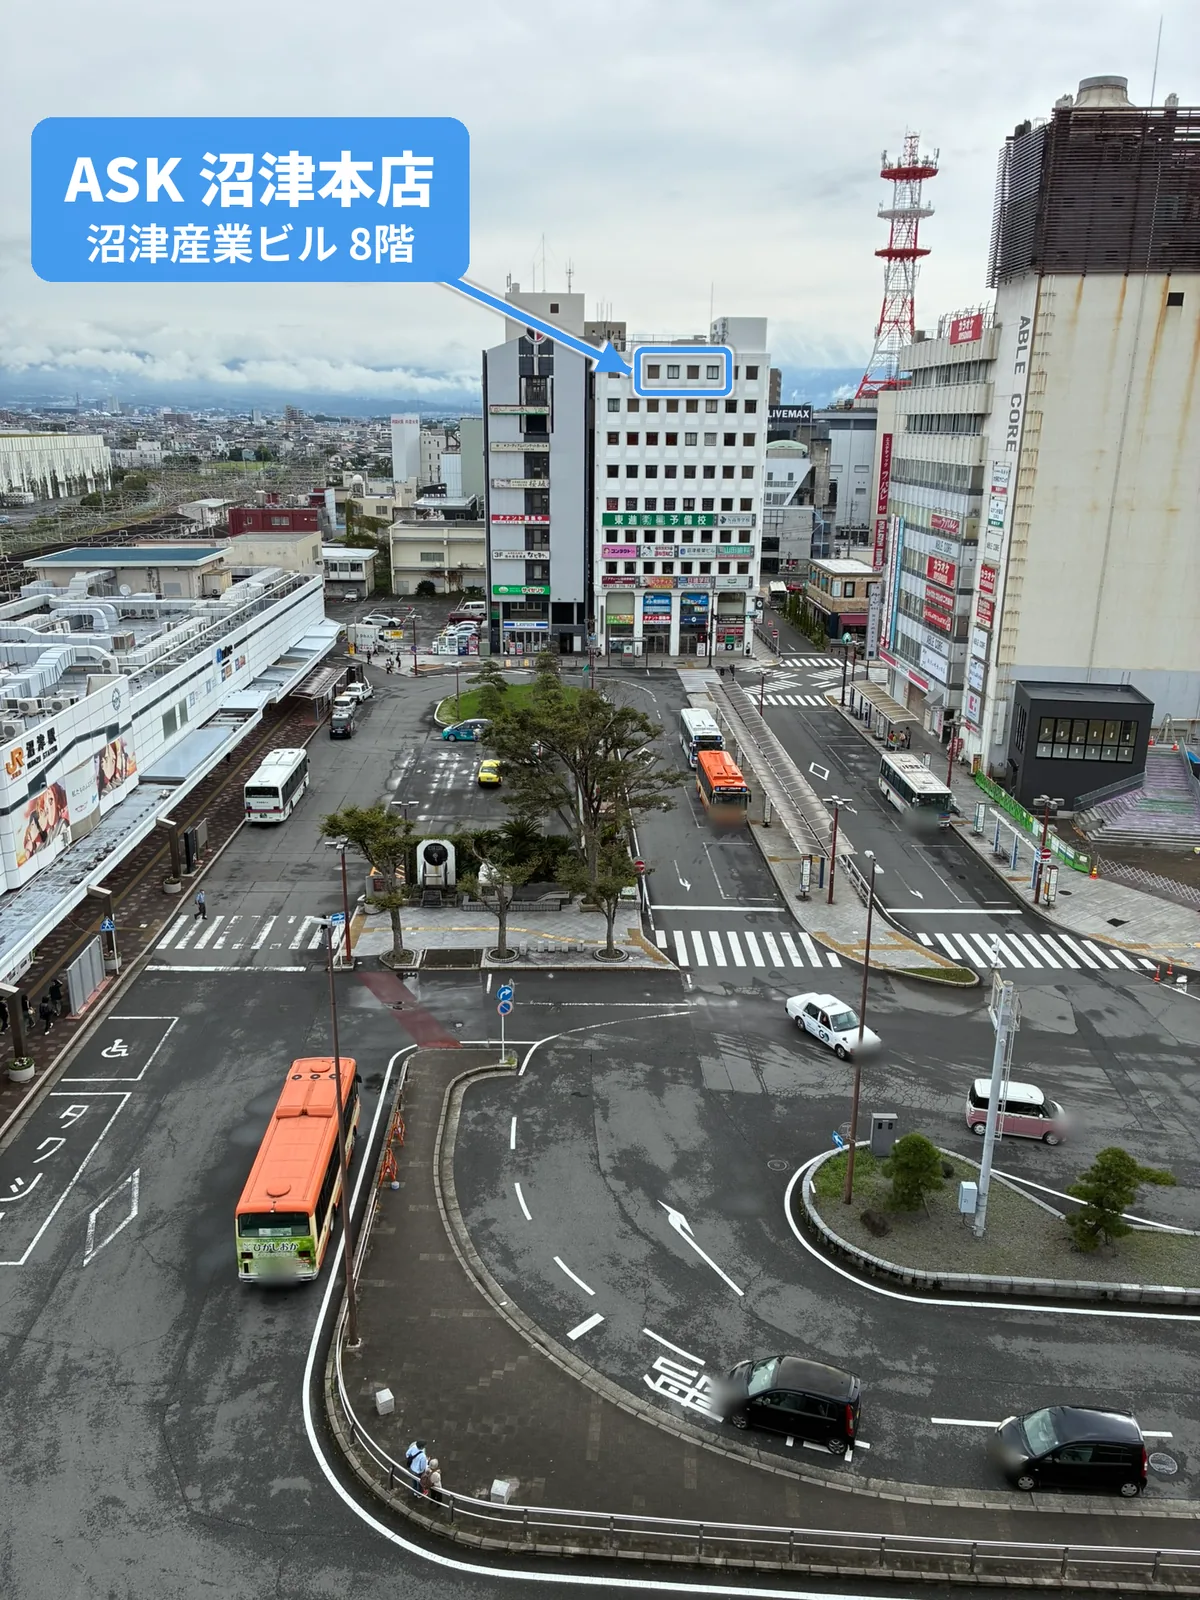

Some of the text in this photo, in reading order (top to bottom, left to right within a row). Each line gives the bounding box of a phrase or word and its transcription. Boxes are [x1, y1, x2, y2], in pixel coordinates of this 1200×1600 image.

[1005, 315, 1031, 453] ABLE CORE
[26, 727, 57, 759] 沼津駅
[5, 746, 25, 775] JR
[253, 1241, 299, 1253] ひがしおか
